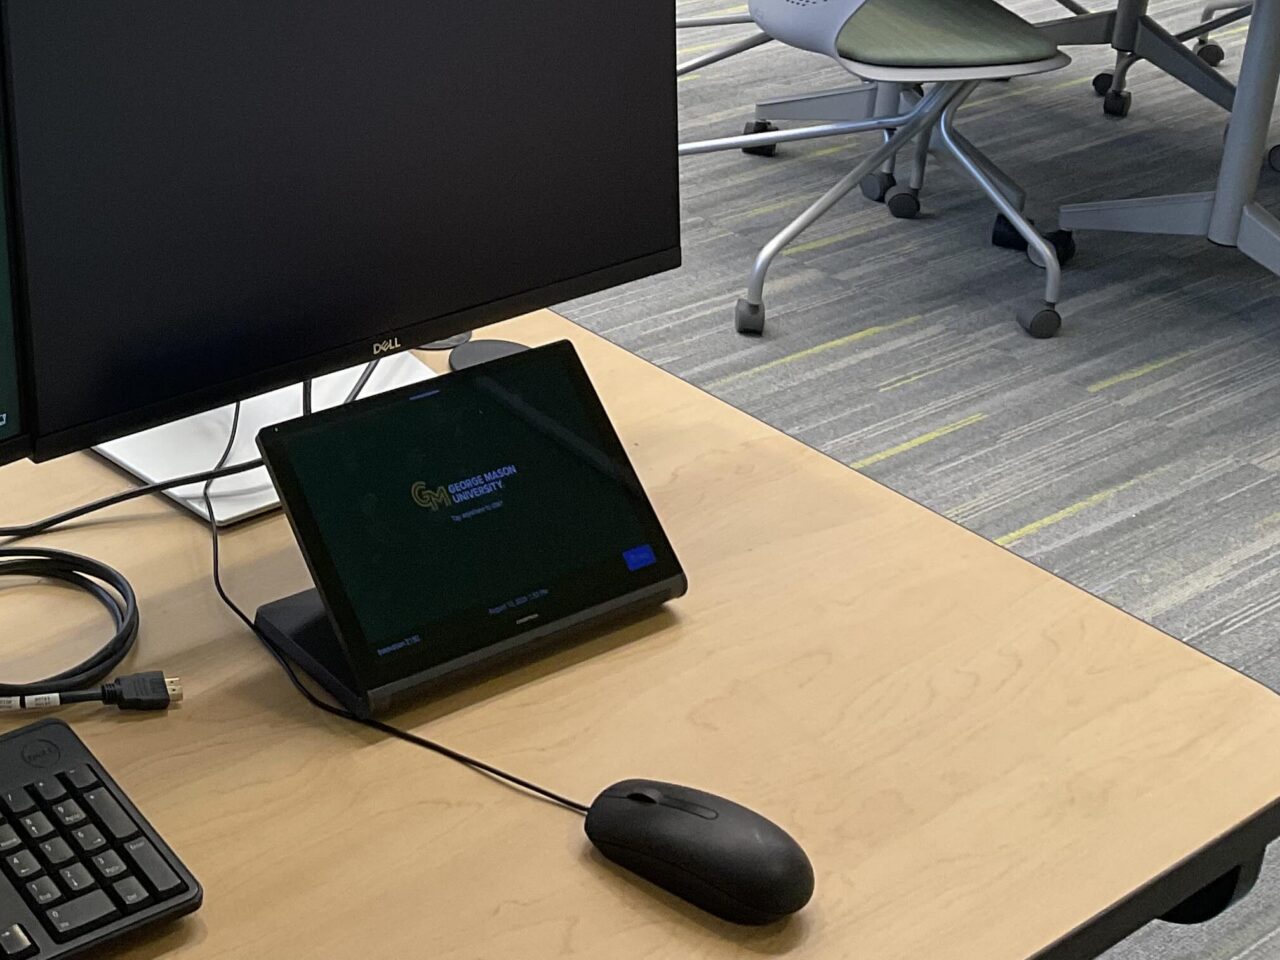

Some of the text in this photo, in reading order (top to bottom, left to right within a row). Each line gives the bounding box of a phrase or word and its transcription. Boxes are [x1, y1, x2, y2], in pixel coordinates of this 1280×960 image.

[372, 337, 401, 355] DELL
[448, 464, 518, 494] GEORGE MASON
[452, 480, 504, 503] UNIVERSITY
